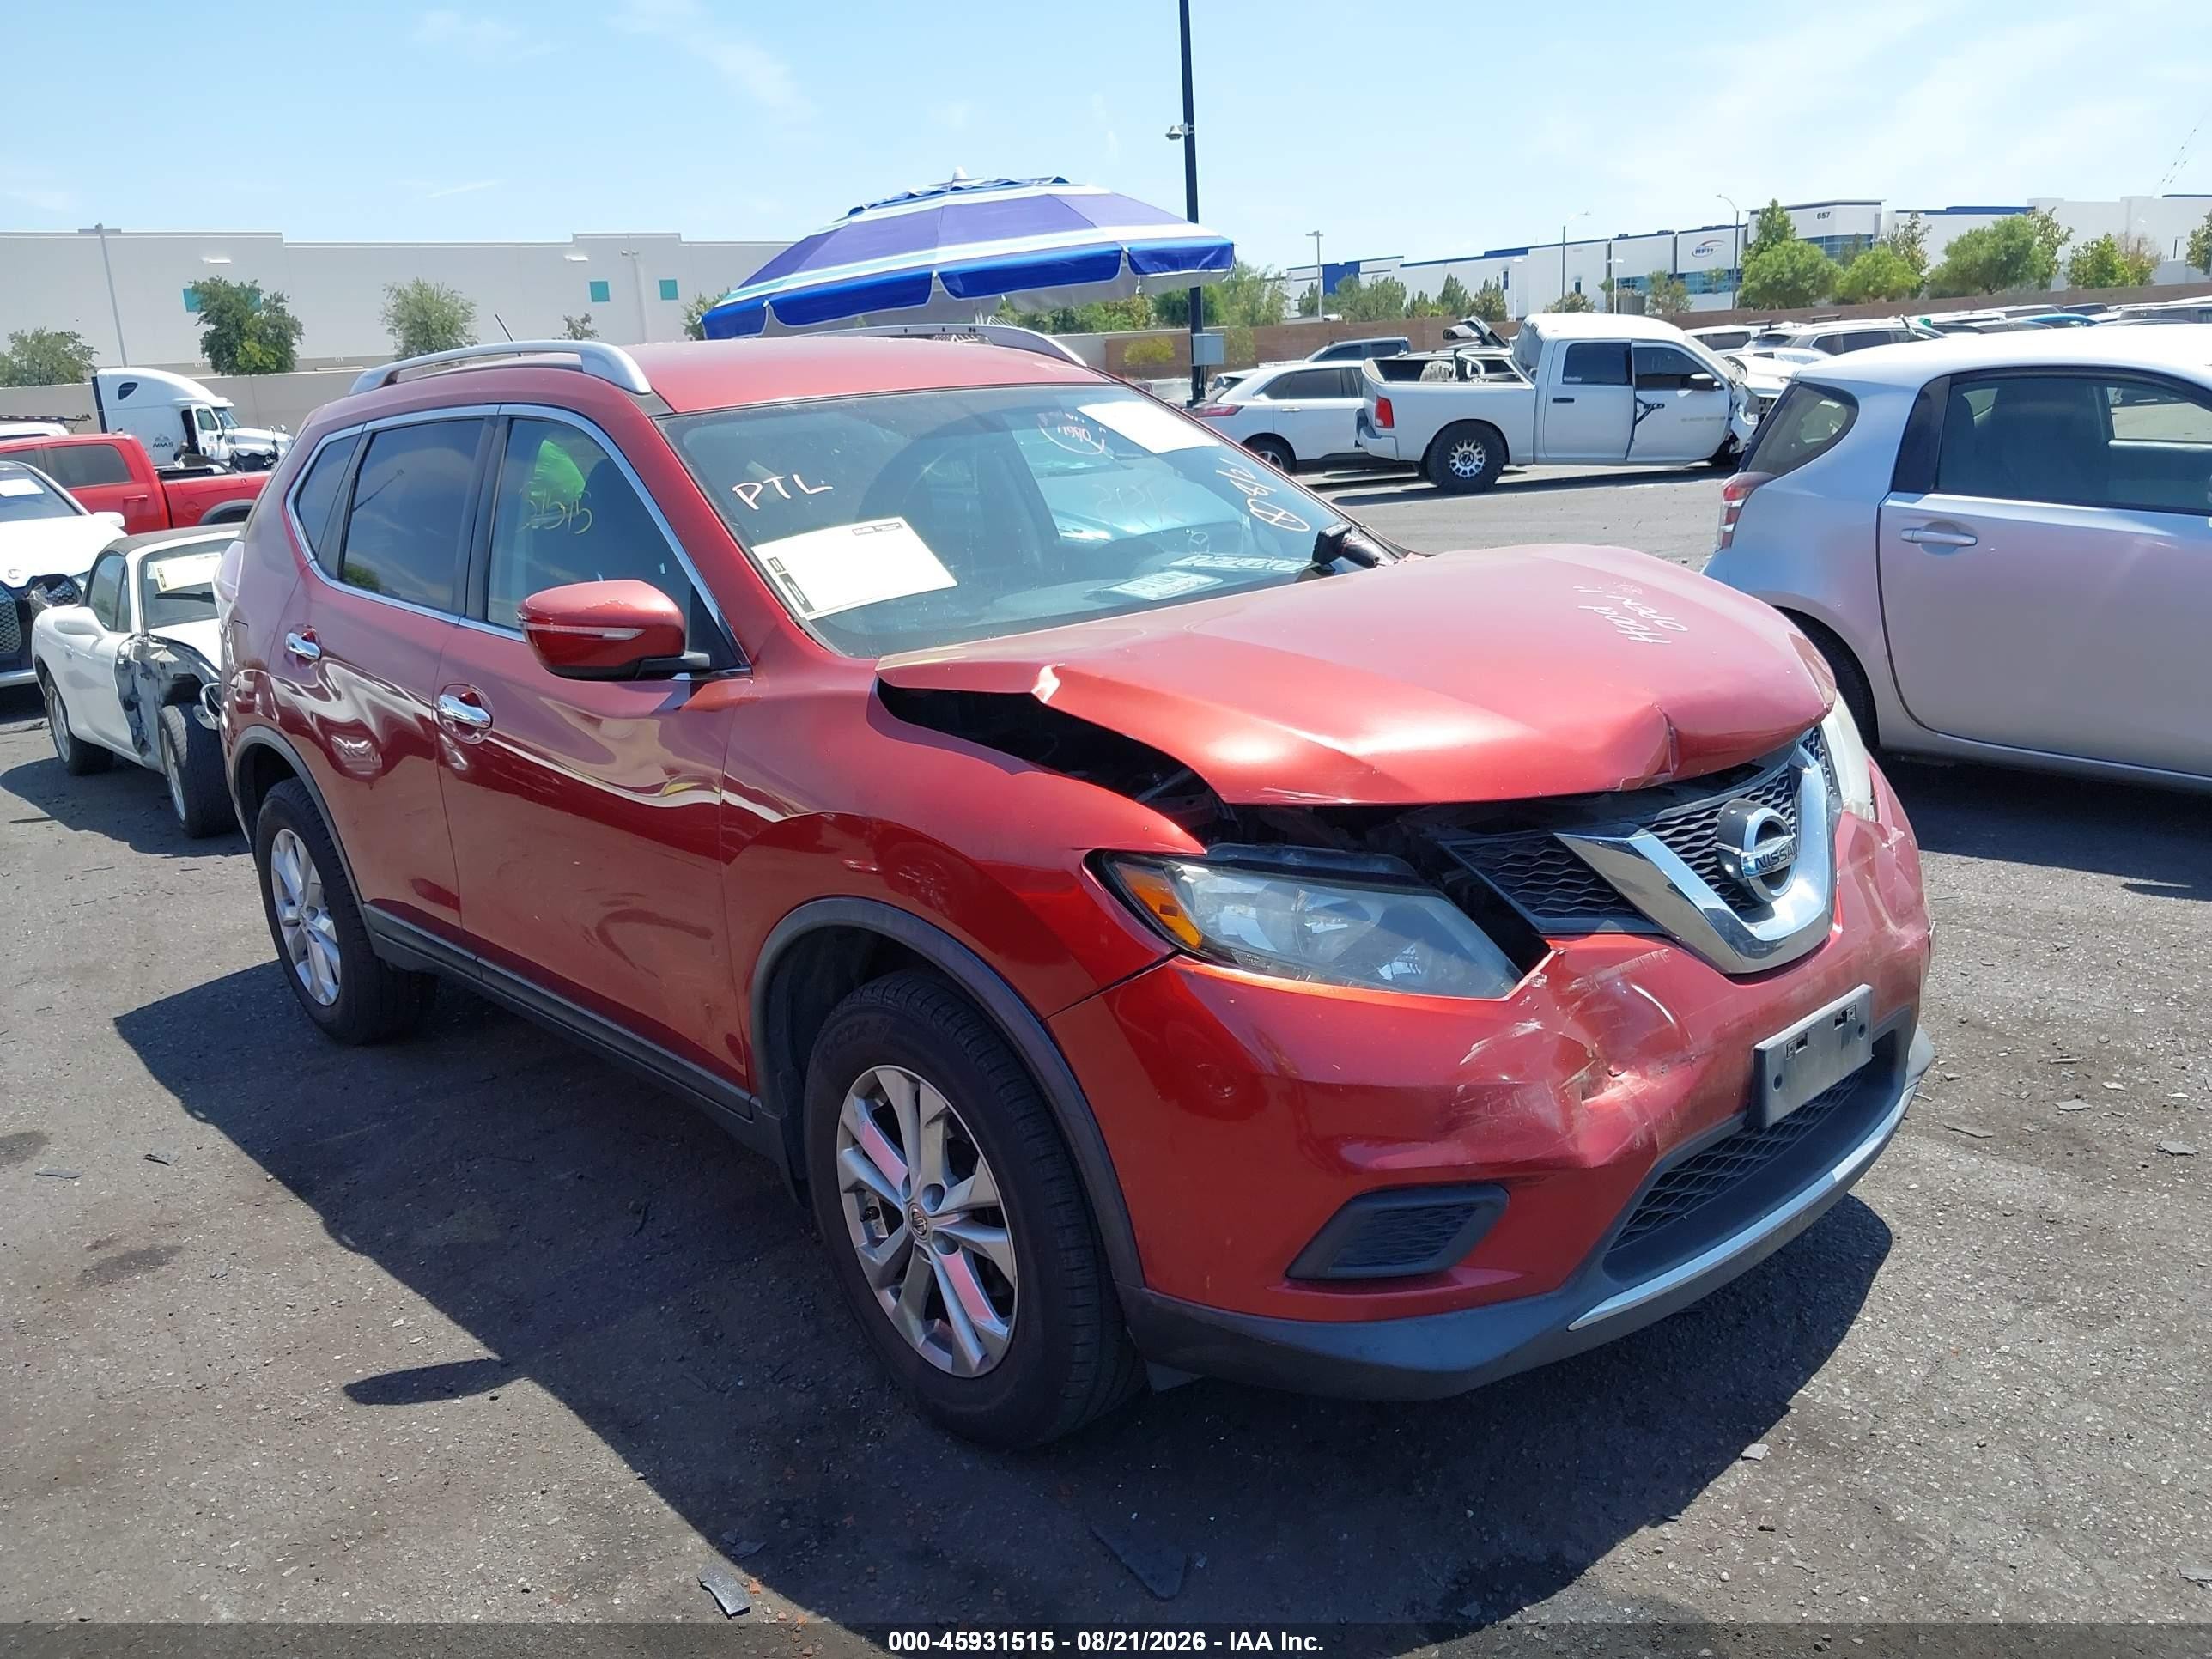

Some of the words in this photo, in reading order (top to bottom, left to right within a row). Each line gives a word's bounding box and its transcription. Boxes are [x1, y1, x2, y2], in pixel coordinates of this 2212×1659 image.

[1816, 211, 1831, 220] 657
[732, 474, 834, 510] PTL
[1754, 841, 1798, 871] NISSAN
